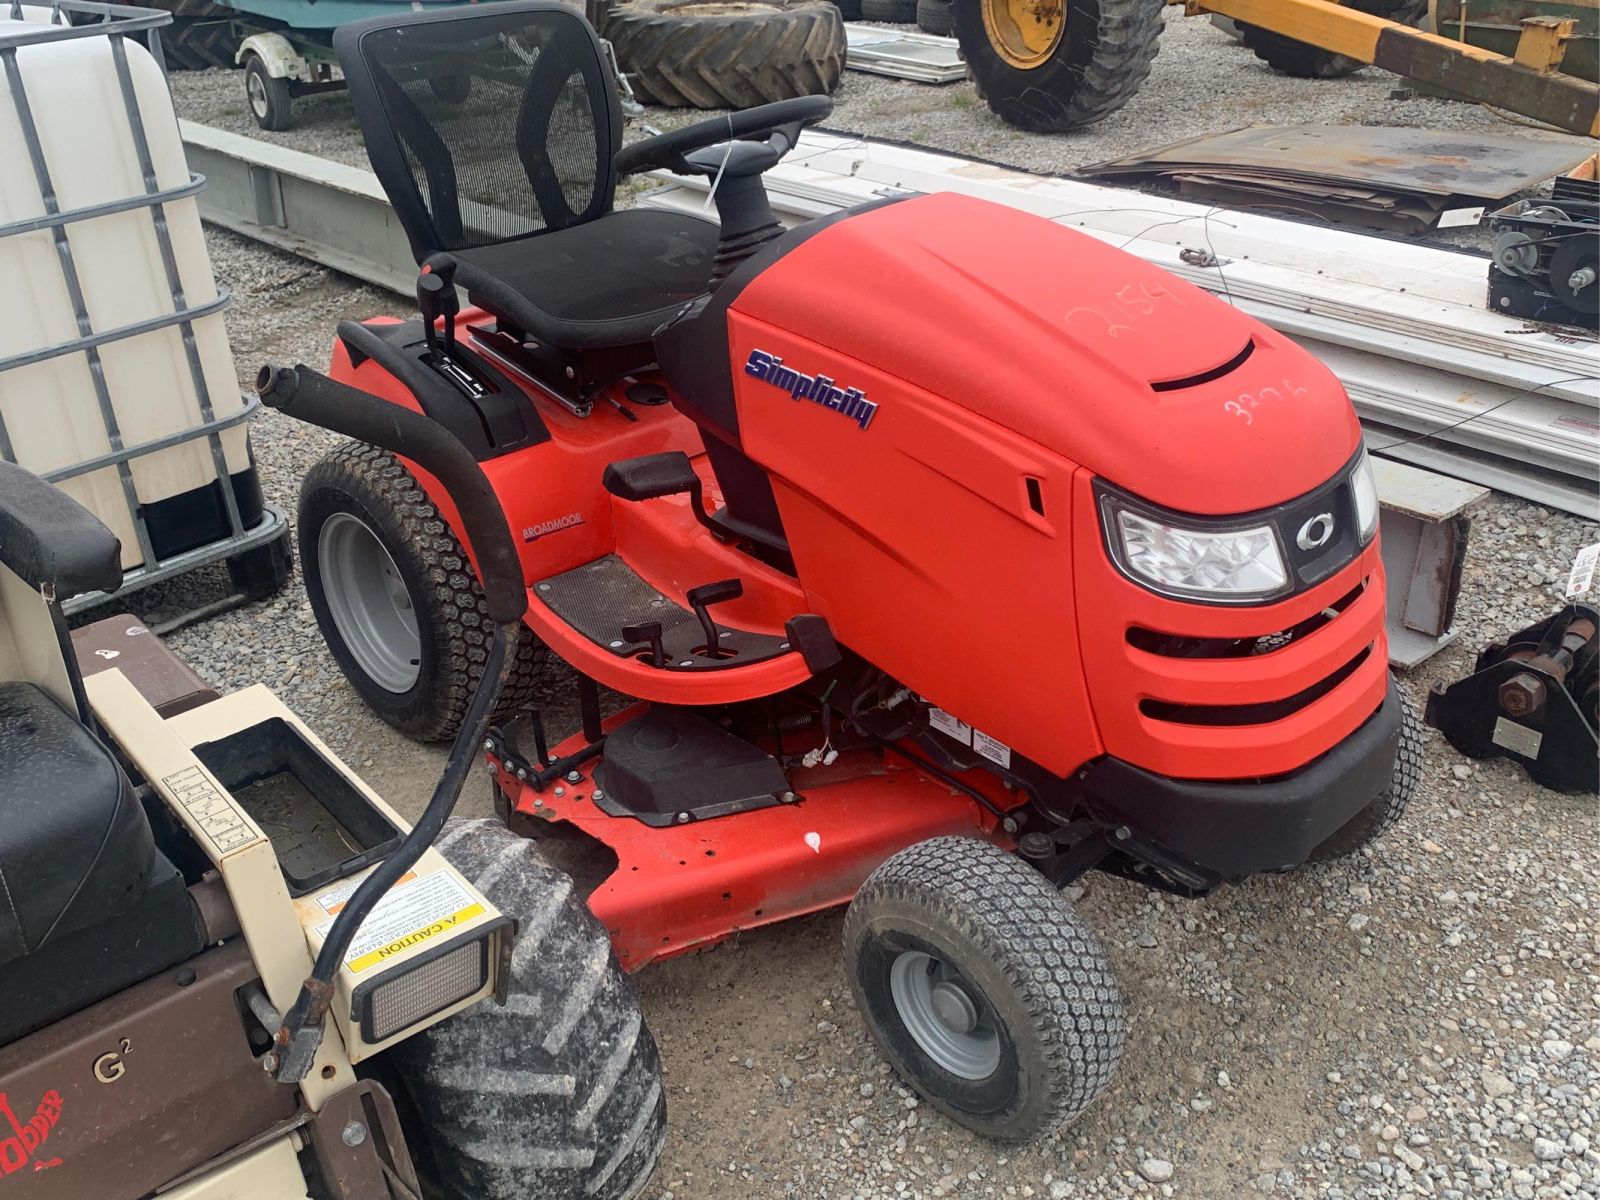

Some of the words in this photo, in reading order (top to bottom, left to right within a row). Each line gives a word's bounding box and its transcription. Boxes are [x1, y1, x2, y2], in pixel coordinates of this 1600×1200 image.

[1065, 280, 1190, 338] 2154
[744, 348, 879, 430] Simplicity
[522, 512, 583, 539] BROADMOOR
[426, 906, 456, 922] AVOID
[379, 924, 443, 958] CAUTION
[383, 919, 427, 942] SERIOUS
[348, 940, 383, 959] INJURY
